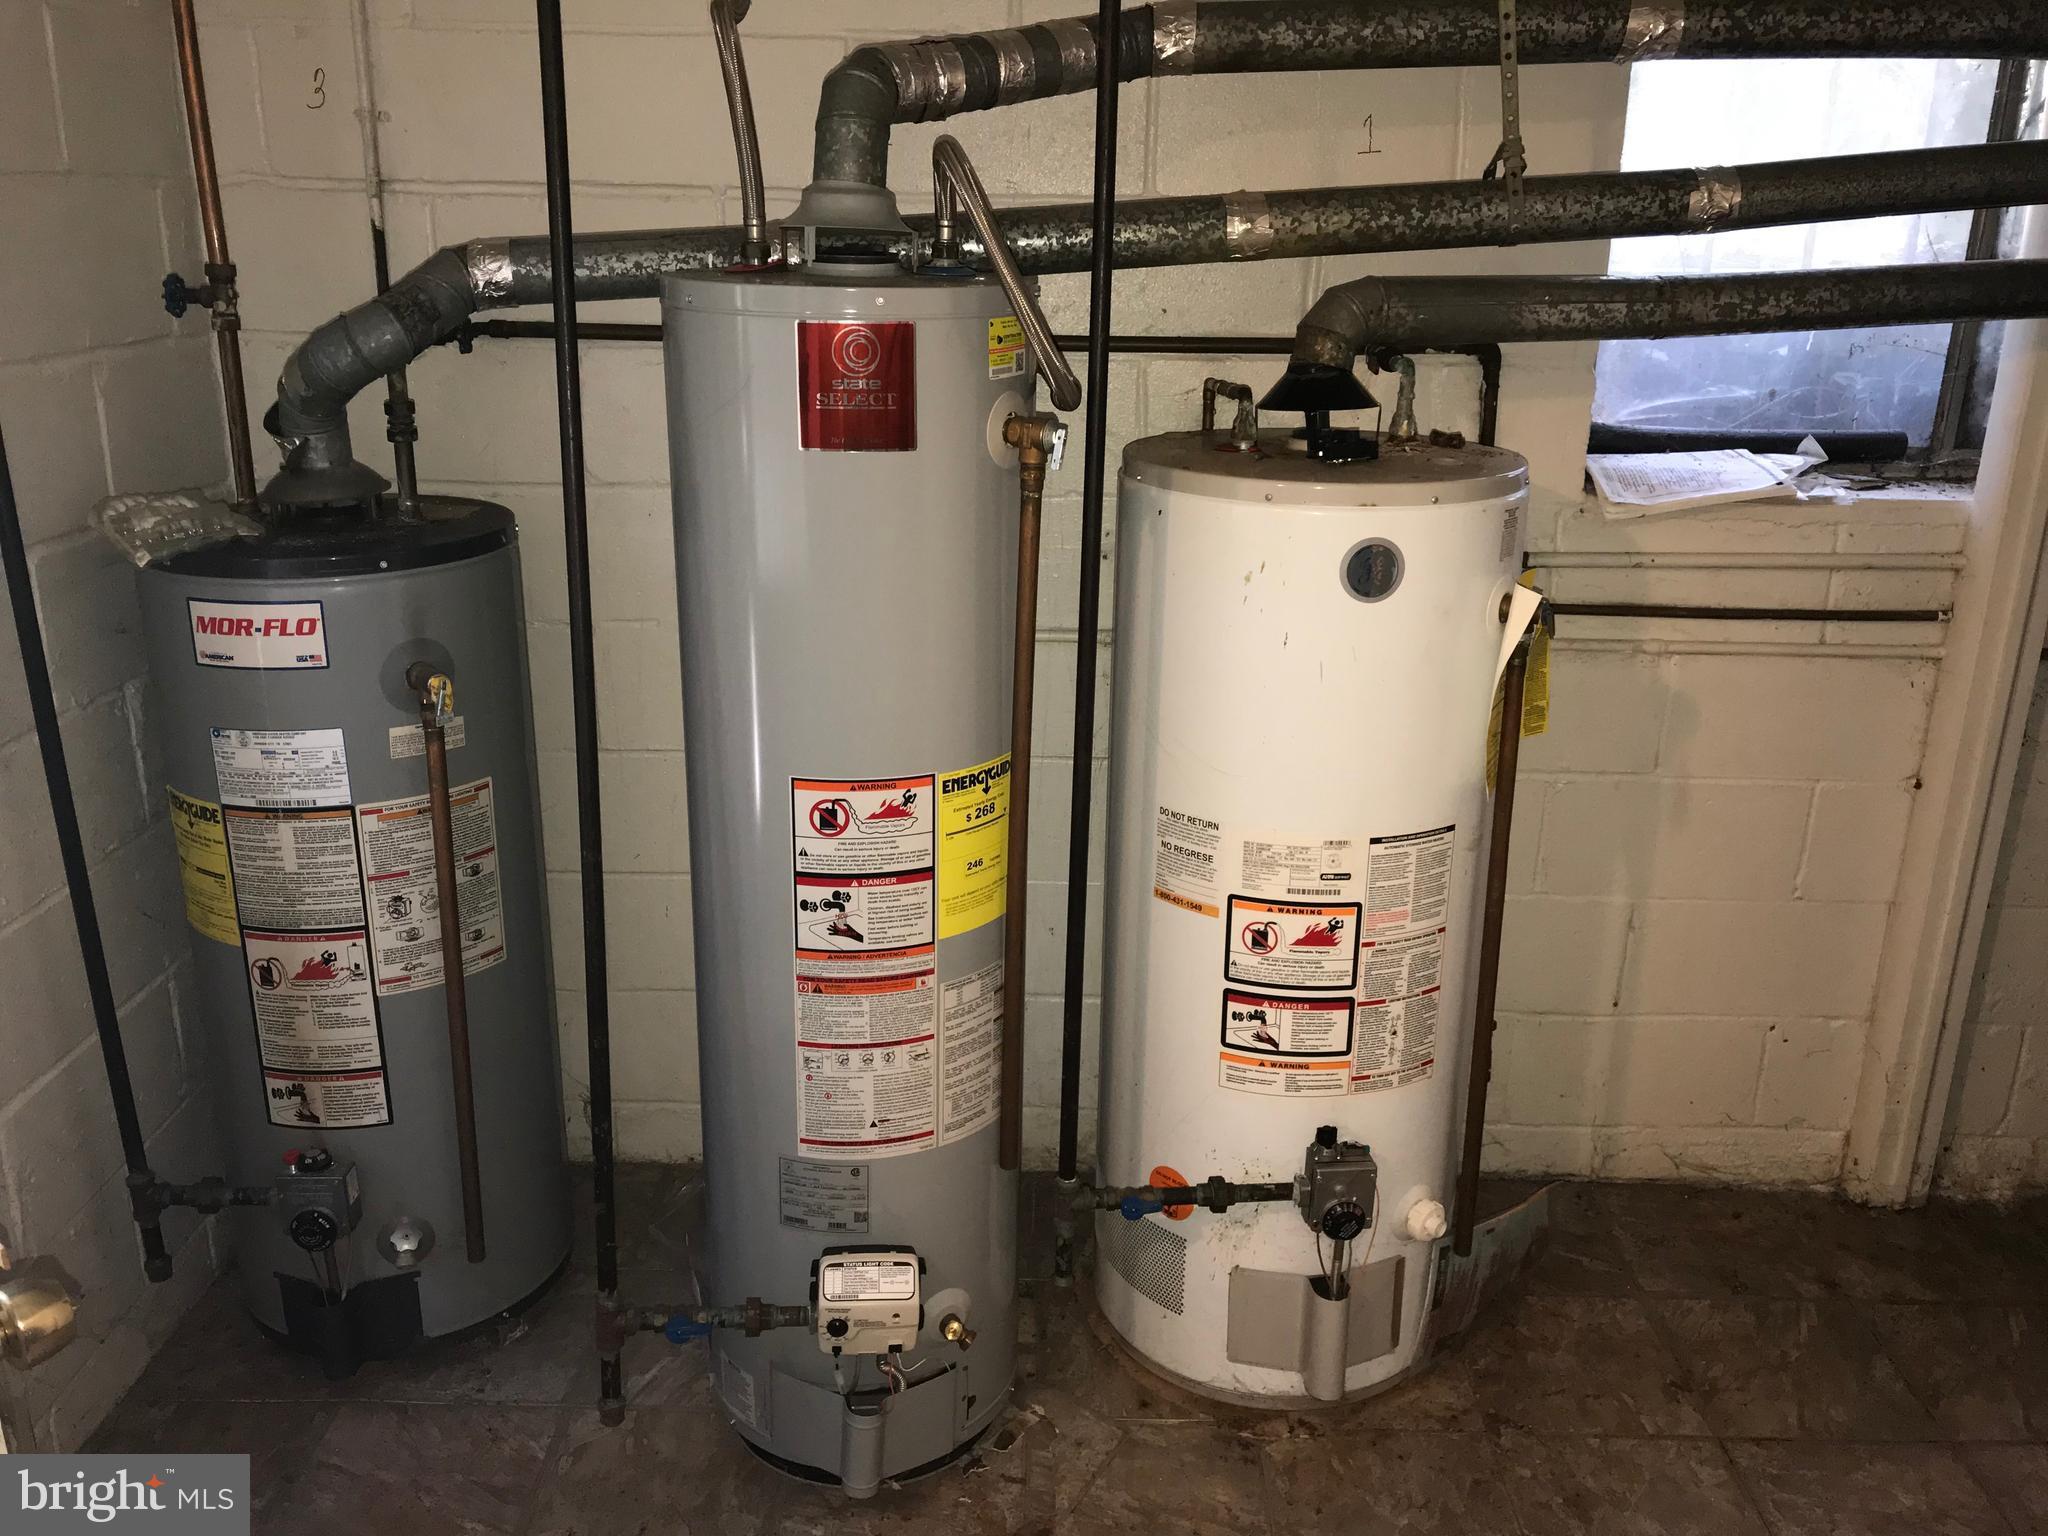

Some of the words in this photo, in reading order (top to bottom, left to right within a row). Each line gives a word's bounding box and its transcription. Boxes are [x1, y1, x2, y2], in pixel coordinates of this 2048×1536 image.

[306, 67, 325, 109] 3
[1357, 113, 1382, 155] 1
[832, 378, 881, 390] state
[816, 392, 897, 405] SELECT
[196, 615, 317, 637] MOR-FLO
[942, 760, 1011, 794] ENERGYGUID
[857, 782, 897, 791] WARNING
[974, 801, 996, 820] 268
[1159, 806, 1170, 817] DO
[1170, 810, 1186, 821] NOT
[1187, 815, 1220, 831] RETURN
[1161, 839, 1172, 851] NO
[1173, 844, 1214, 864] REGRESE
[966, 858, 984, 871] 246
[861, 877, 897, 886] DANGER
[1277, 907, 1323, 915] WARNING
[1272, 1001, 1310, 1010] DANGER
[1270, 1062, 1310, 1070] WARNING
